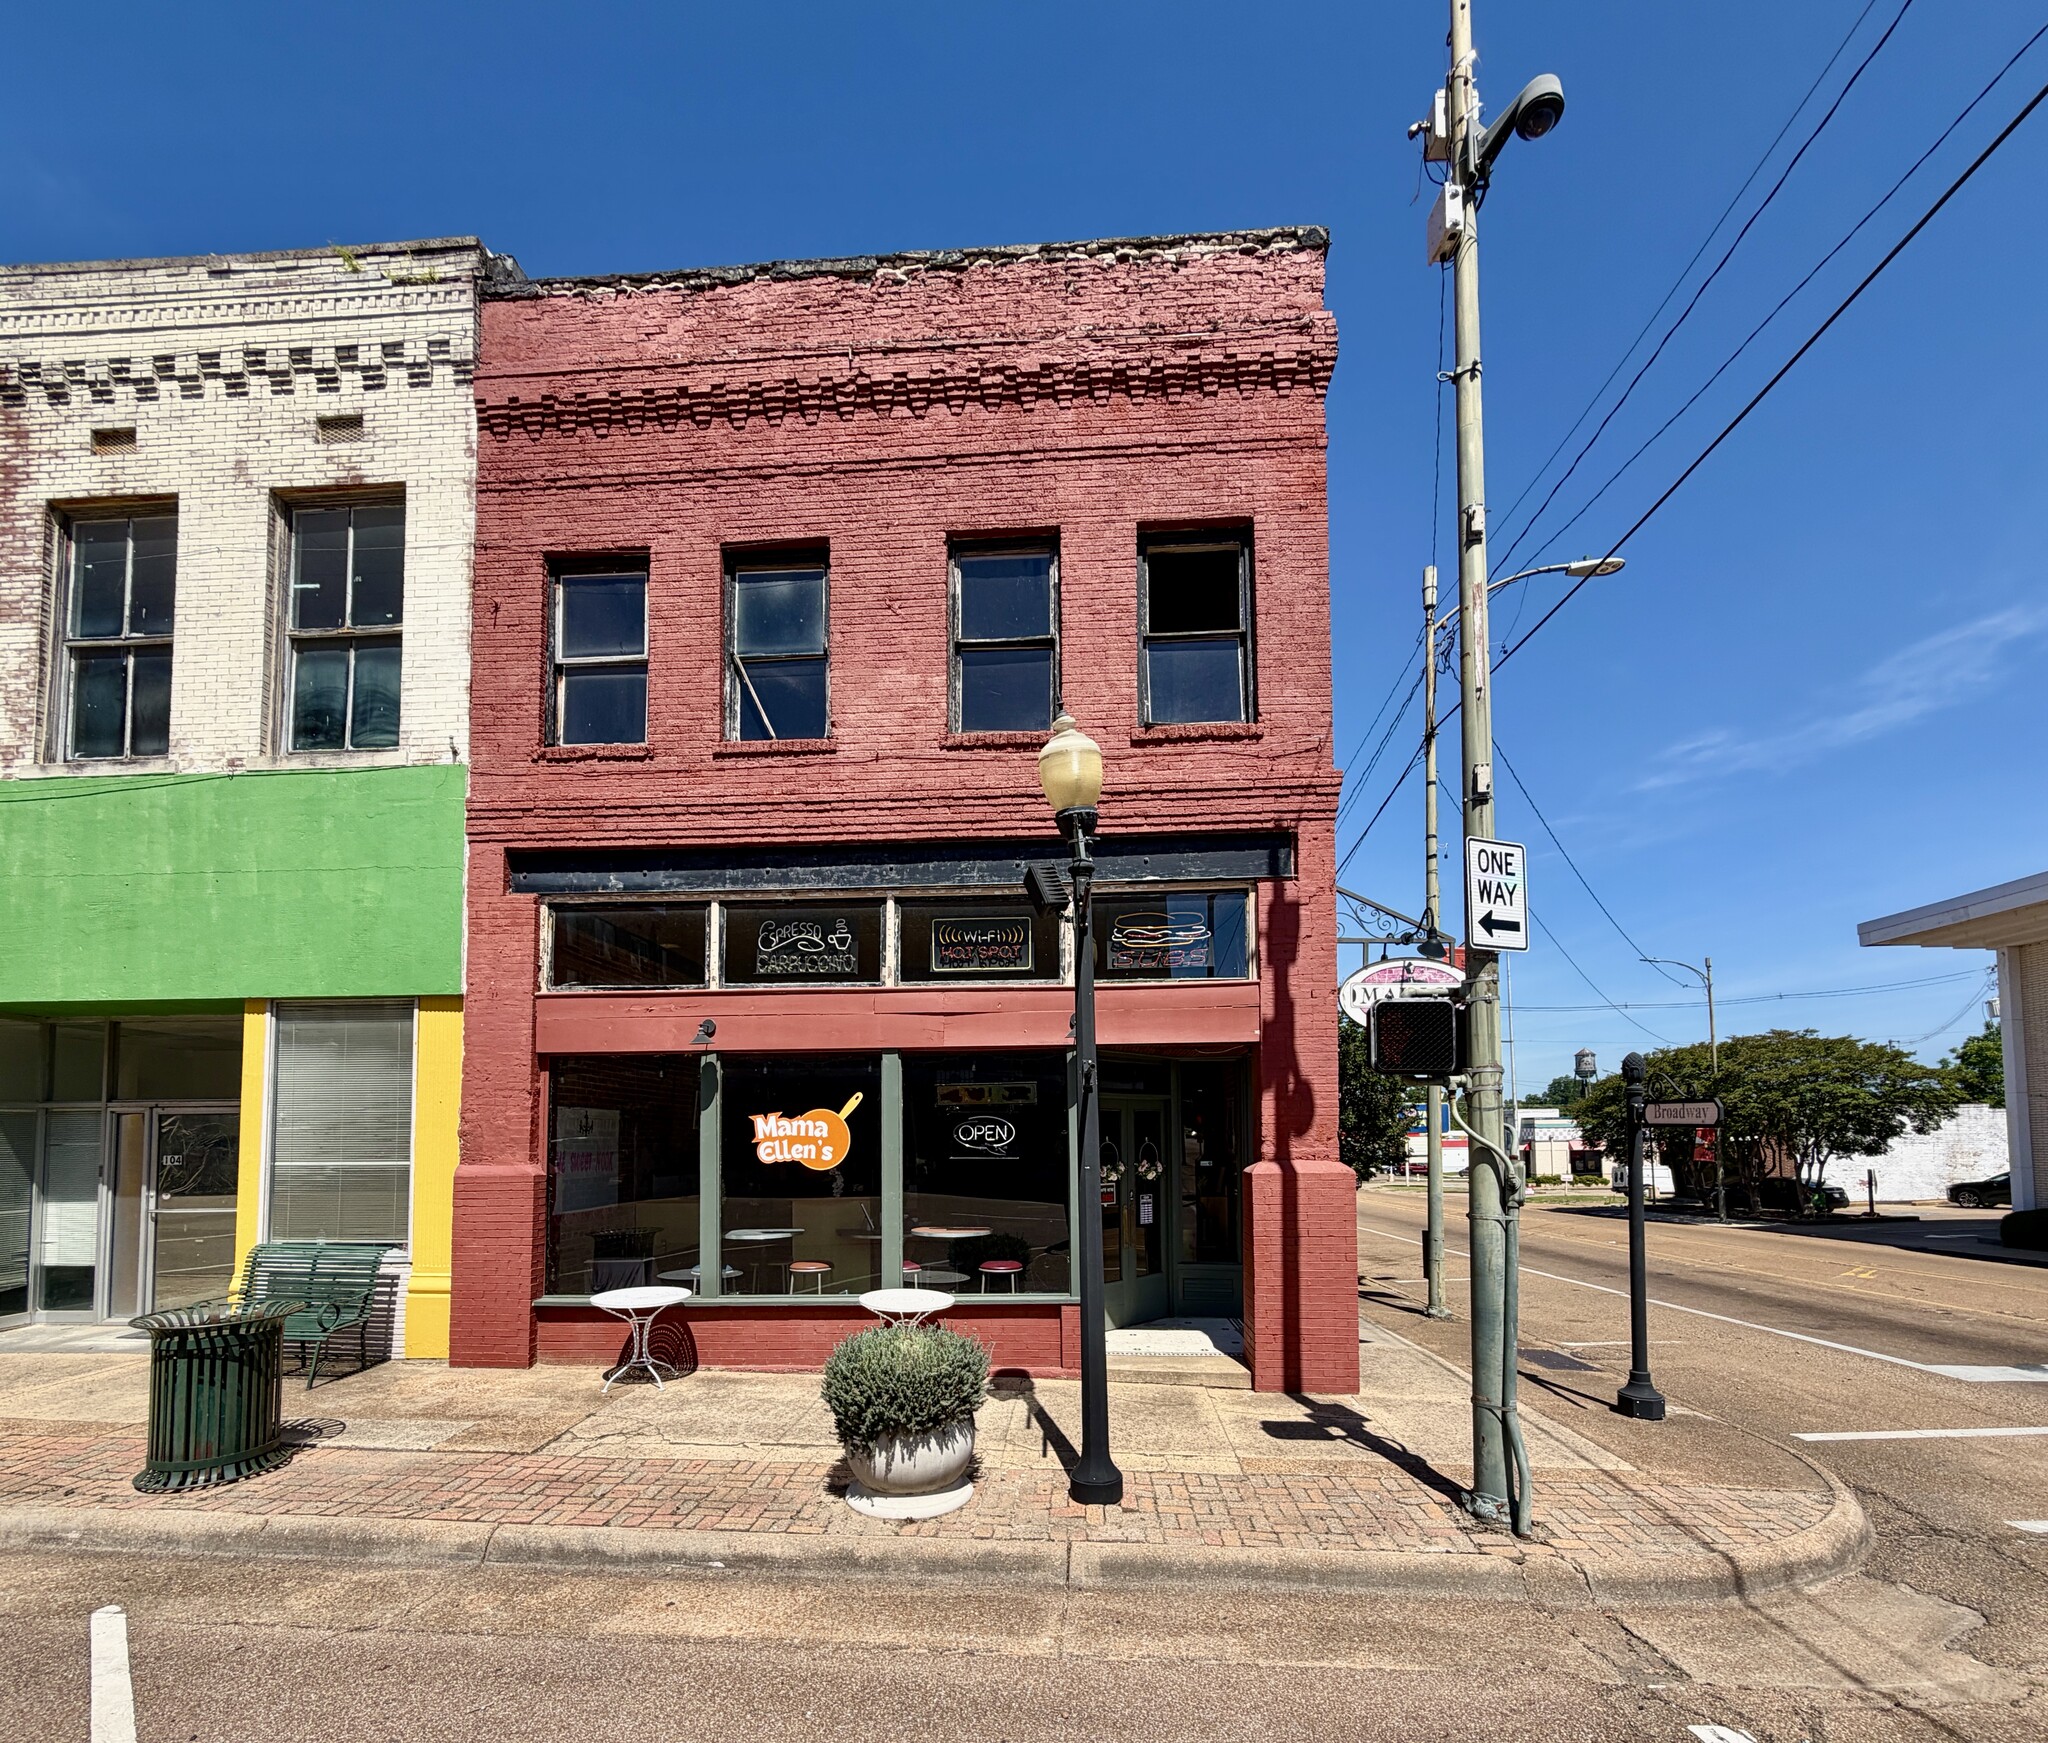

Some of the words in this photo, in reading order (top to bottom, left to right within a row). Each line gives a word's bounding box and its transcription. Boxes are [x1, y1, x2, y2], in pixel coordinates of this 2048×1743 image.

[1477, 848, 1516, 877] ONE
[1477, 878, 1518, 907] WAY
[941, 945, 975, 959] HOT
[978, 944, 1021, 959] SPOT
[1113, 947, 1208, 967] SUBS
[757, 954, 857, 973] CAPPUCCINO
[1654, 1103, 1709, 1119] Broadway
[755, 1115, 829, 1139] Mama
[958, 1124, 1008, 1141] OPEN
[760, 1139, 834, 1161] Ellen's
[164, 1155, 181, 1165] 104
